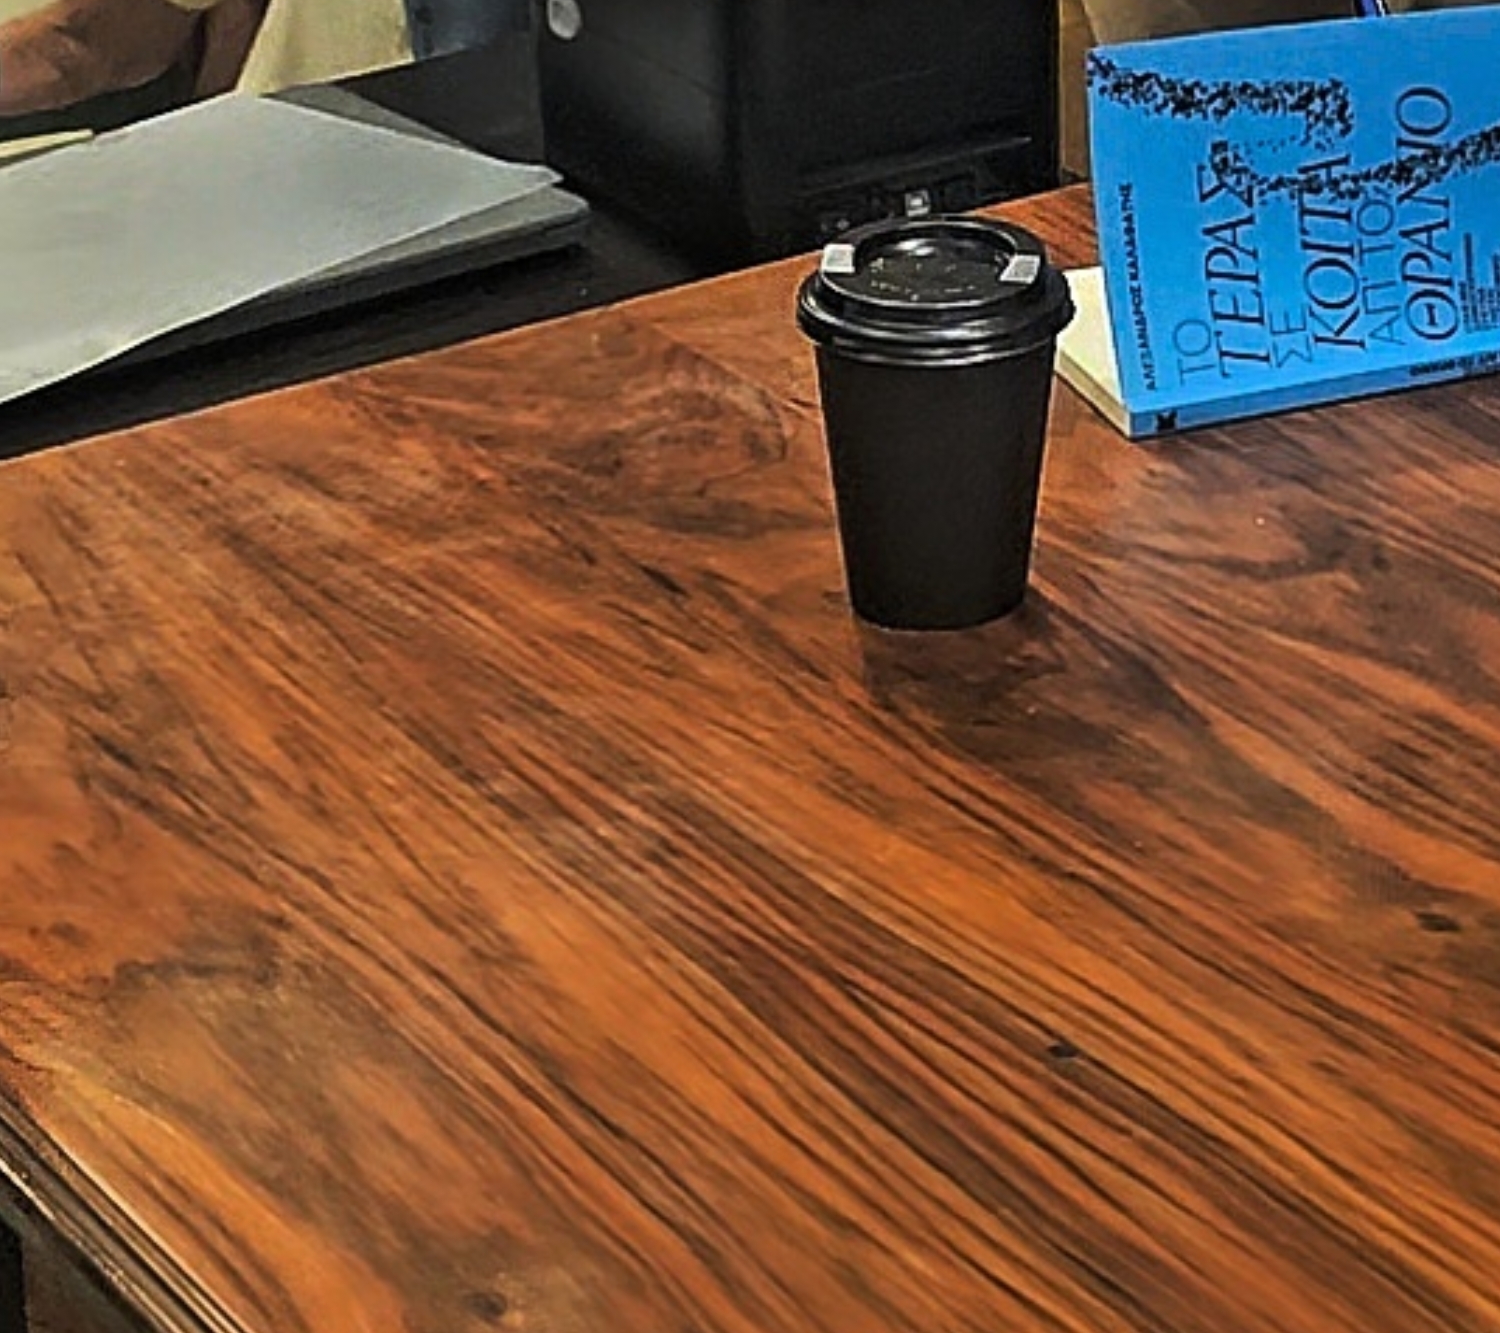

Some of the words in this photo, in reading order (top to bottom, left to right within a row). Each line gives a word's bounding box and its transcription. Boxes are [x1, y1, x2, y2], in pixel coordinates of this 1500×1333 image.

[1297, 153, 1366, 352] ΚΟΙΤΑ
[1355, 197, 1396, 264] ΤΟ
[1396, 86, 1459, 341] ΘΡΑΝΙΟ
[1197, 163, 1270, 378] ΤΕΡΑΣ
[1128, 283, 1157, 392] ΑΛΕΞΑΝΔΡΟΣ
[1173, 319, 1216, 386] ΤΟ
[1268, 307, 1313, 368] ΣΕ
